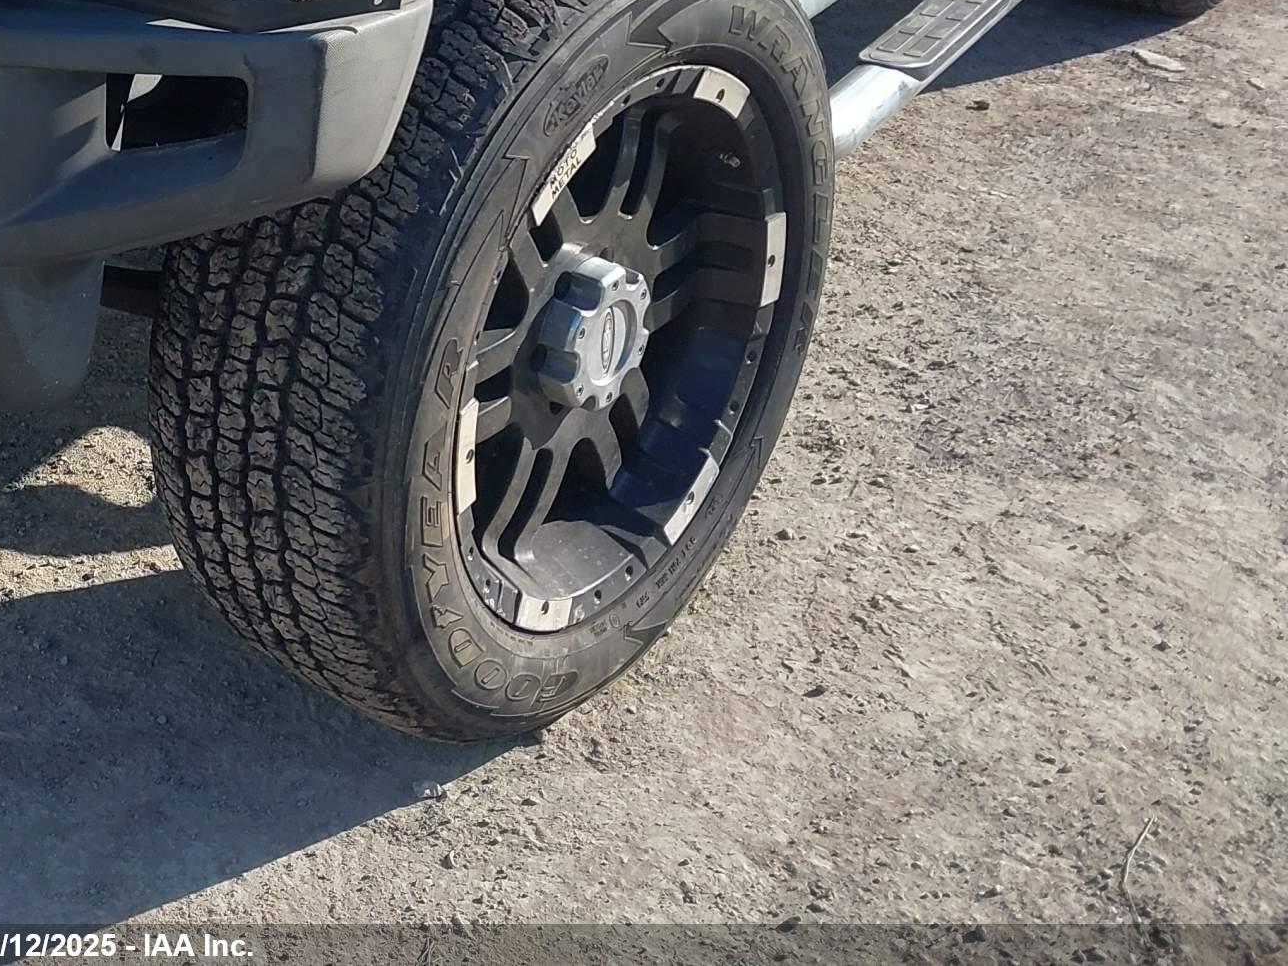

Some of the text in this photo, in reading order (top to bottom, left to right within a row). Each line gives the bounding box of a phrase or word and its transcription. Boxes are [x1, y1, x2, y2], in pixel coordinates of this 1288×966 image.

[551, 149, 578, 186] MOTO
[551, 159, 582, 199] METAL
[728, 4, 828, 354] WRANGLER
[420, 338, 578, 703] GOODYEAR
